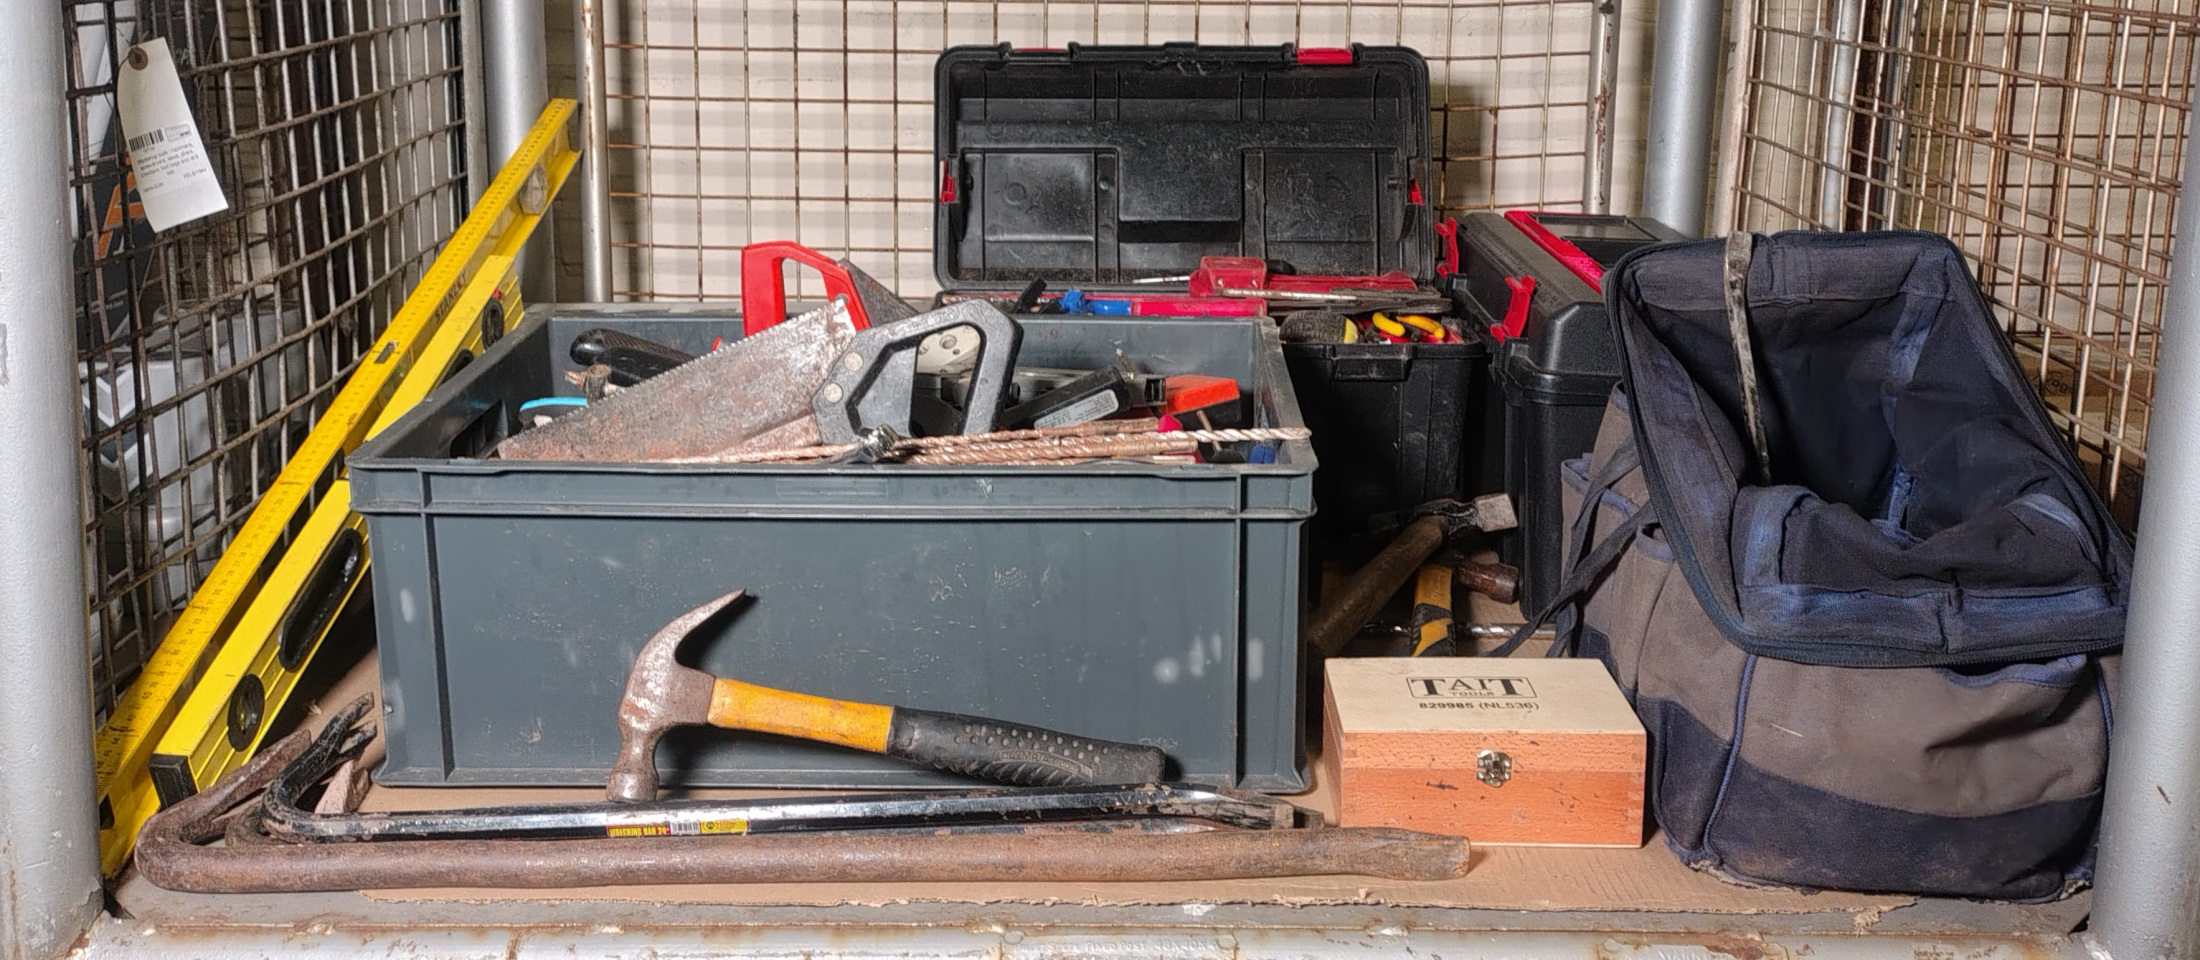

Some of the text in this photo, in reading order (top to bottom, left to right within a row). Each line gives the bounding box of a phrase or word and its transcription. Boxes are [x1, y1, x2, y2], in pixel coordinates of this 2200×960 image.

[434, 269, 466, 326] STANLEY
[1411, 679, 1524, 697] TAIT
[1478, 702, 1540, 710] (NL536)
[1000, 750, 1050, 764] OLYMPIA
